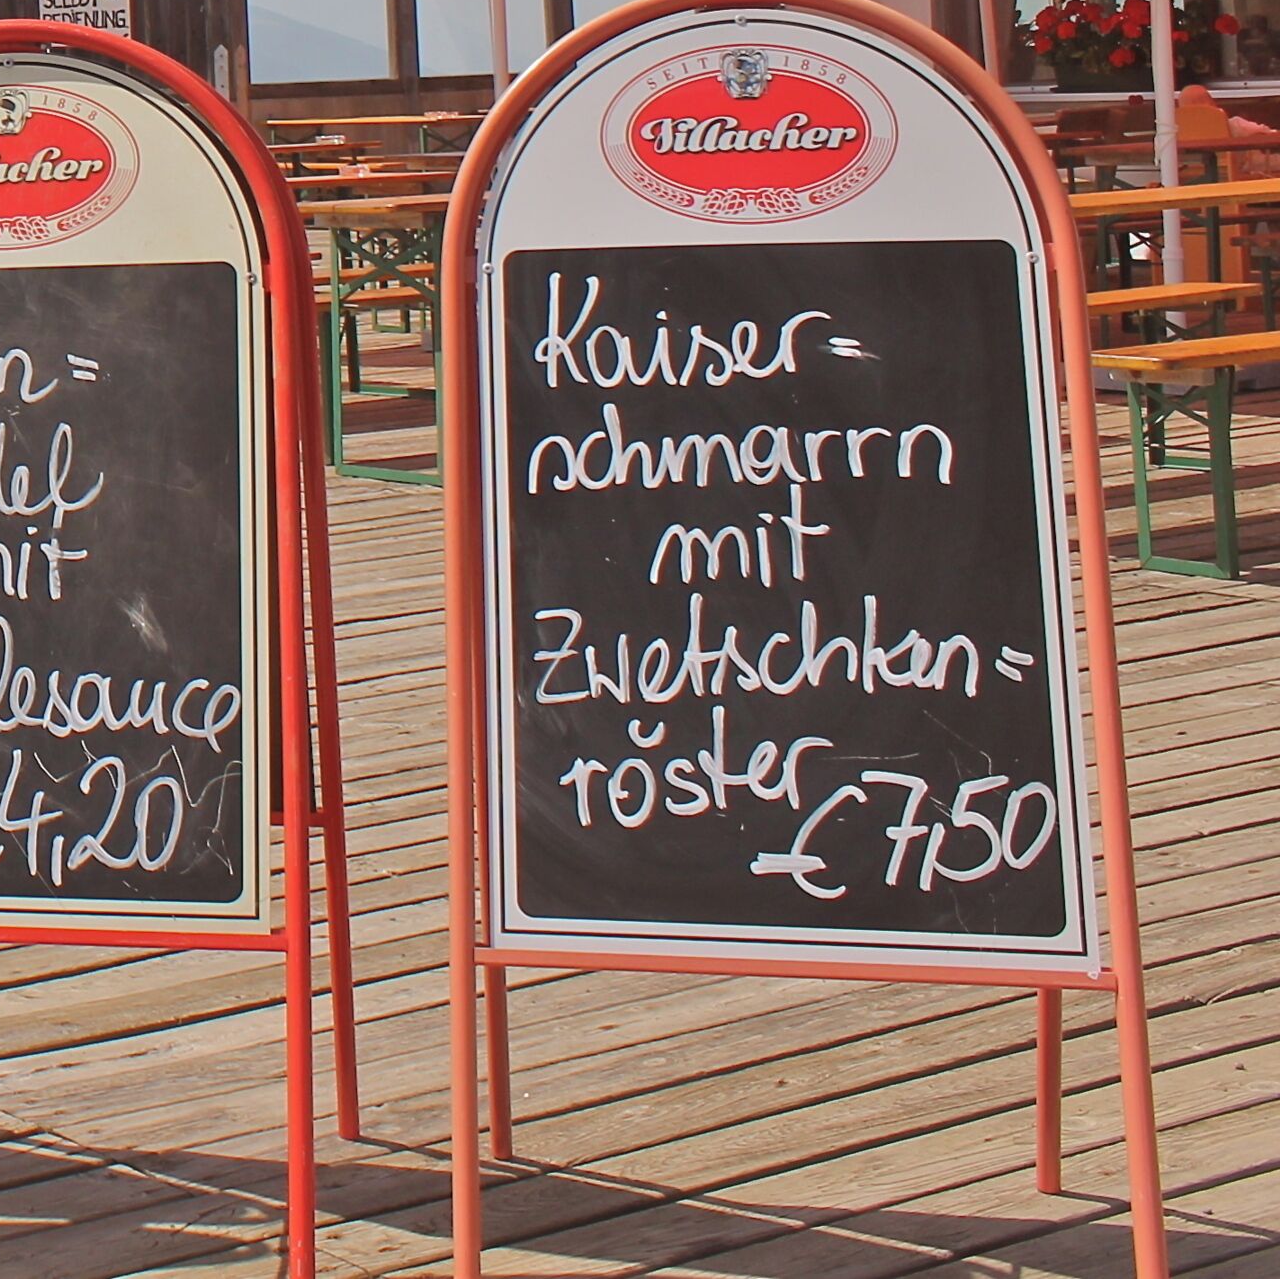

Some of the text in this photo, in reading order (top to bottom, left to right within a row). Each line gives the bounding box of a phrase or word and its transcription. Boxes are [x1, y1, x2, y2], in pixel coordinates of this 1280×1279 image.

[646, 55, 847, 91] SEIT 1858
[41, 95, 99, 122] 1858
[640, 112, 858, 156] Villacher
[527, 403, 954, 495] schmarrn
[649, 483, 831, 588] mit
